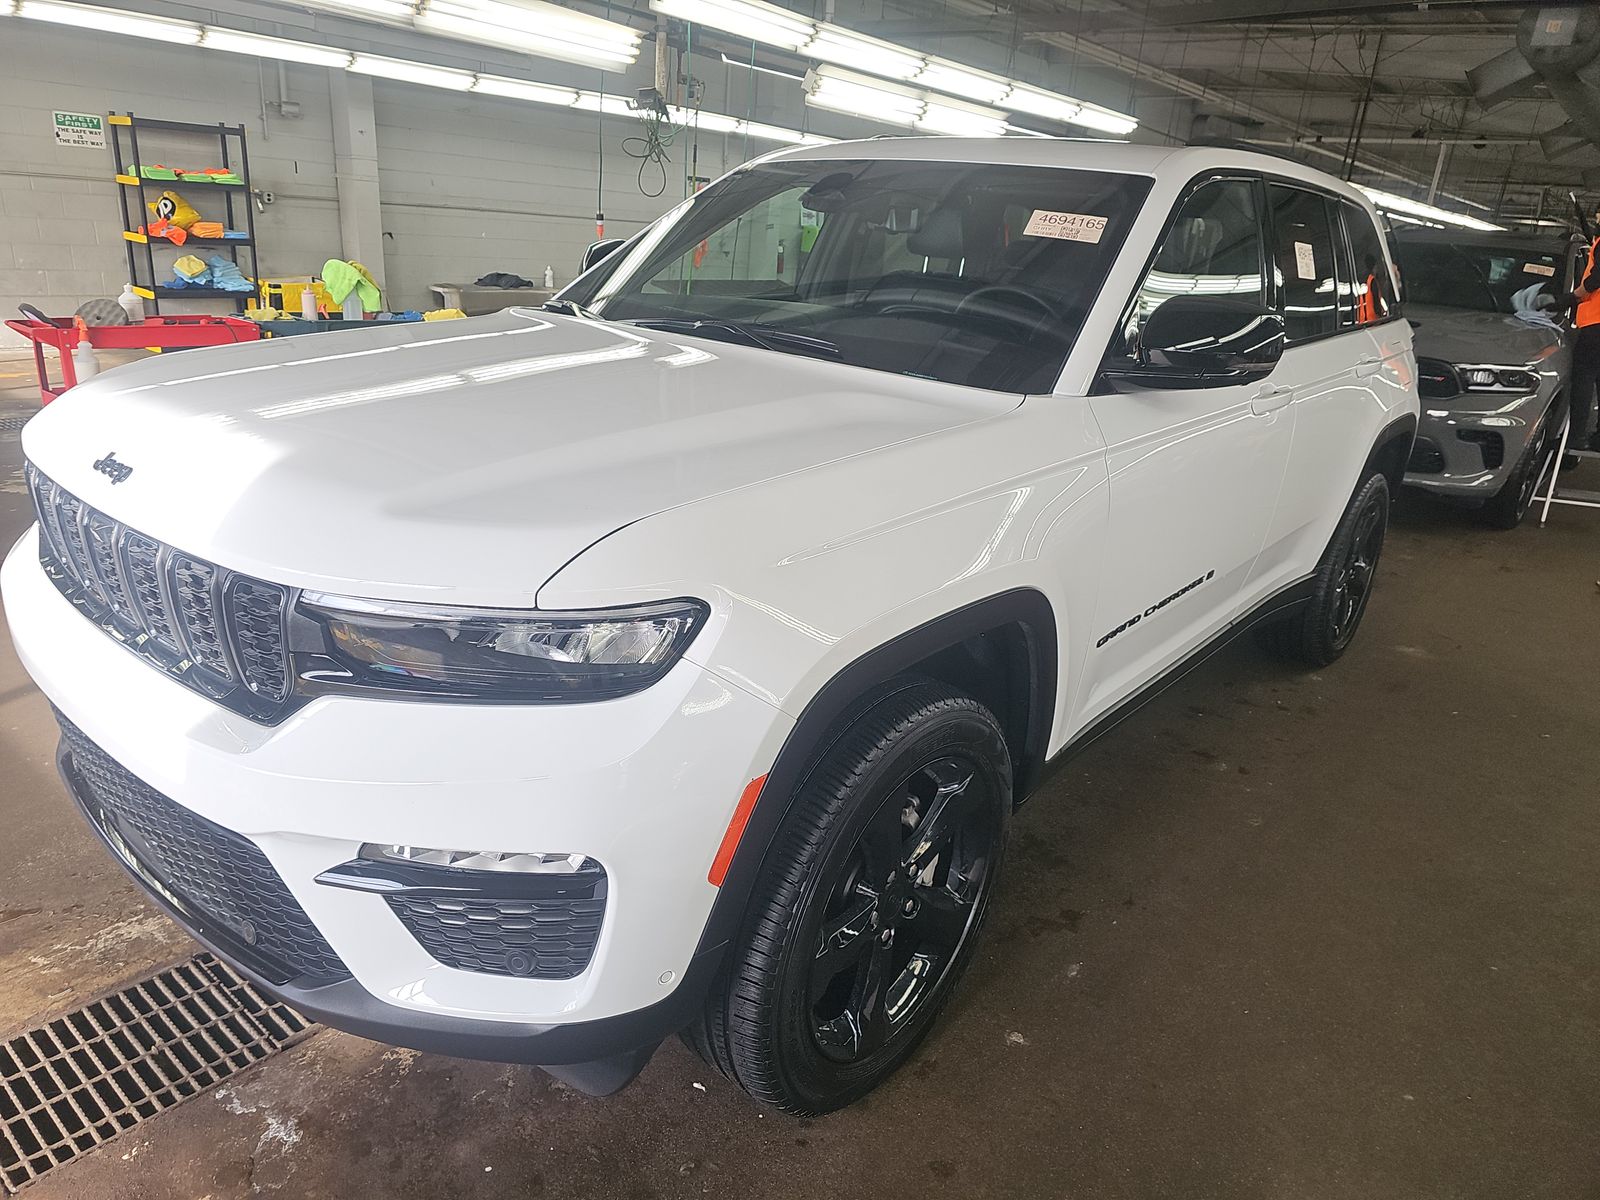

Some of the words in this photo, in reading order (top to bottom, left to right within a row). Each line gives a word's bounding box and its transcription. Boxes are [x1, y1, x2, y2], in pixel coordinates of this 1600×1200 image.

[57, 114, 98, 124] SAFETY
[1039, 214, 1106, 230] 4694165
[92, 451, 133, 485] Jeep
[1096, 614, 1142, 648] GRAND
